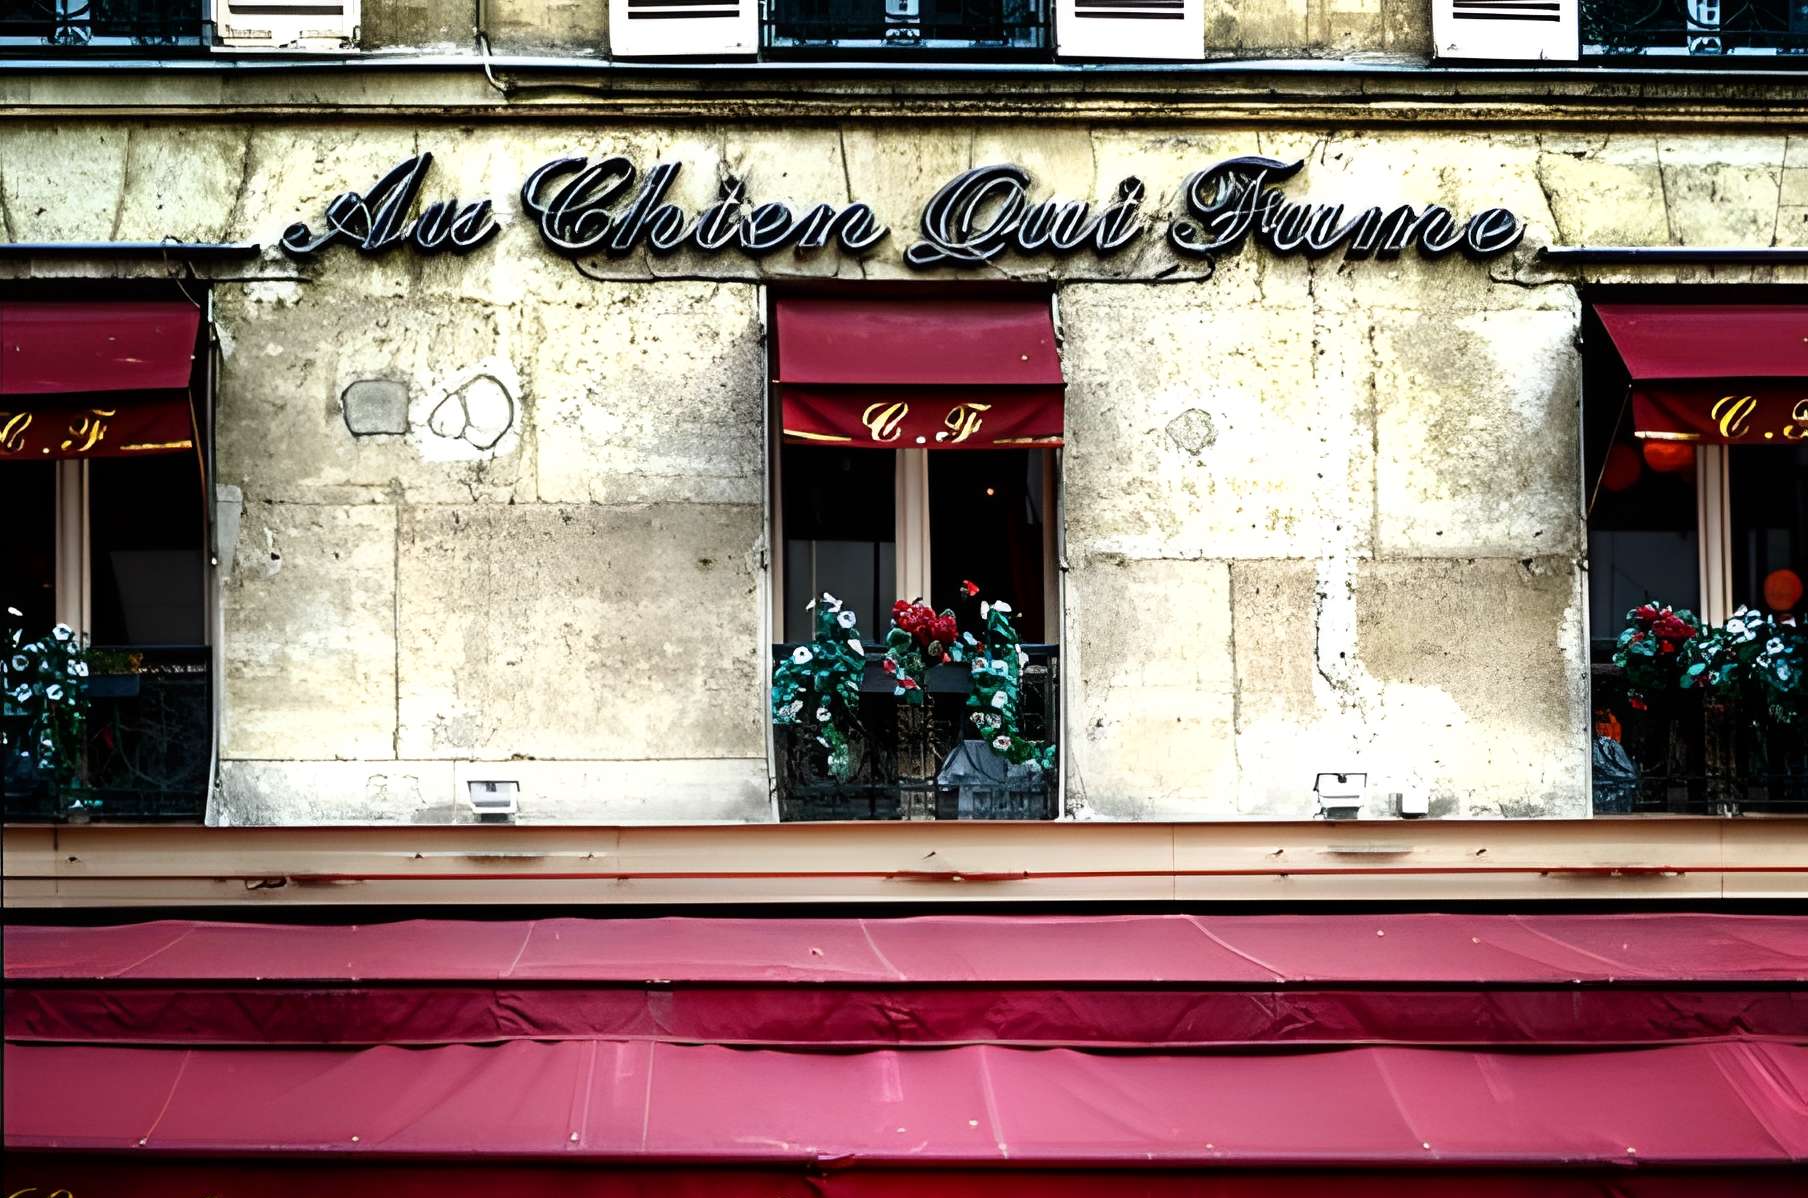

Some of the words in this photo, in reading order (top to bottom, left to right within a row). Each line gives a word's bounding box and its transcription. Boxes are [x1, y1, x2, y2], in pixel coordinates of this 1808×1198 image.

[281, 151, 501, 258] Au
[520, 156, 892, 256] Chien
[903, 162, 1146, 268] Qui
[1166, 155, 1526, 259] Fume
